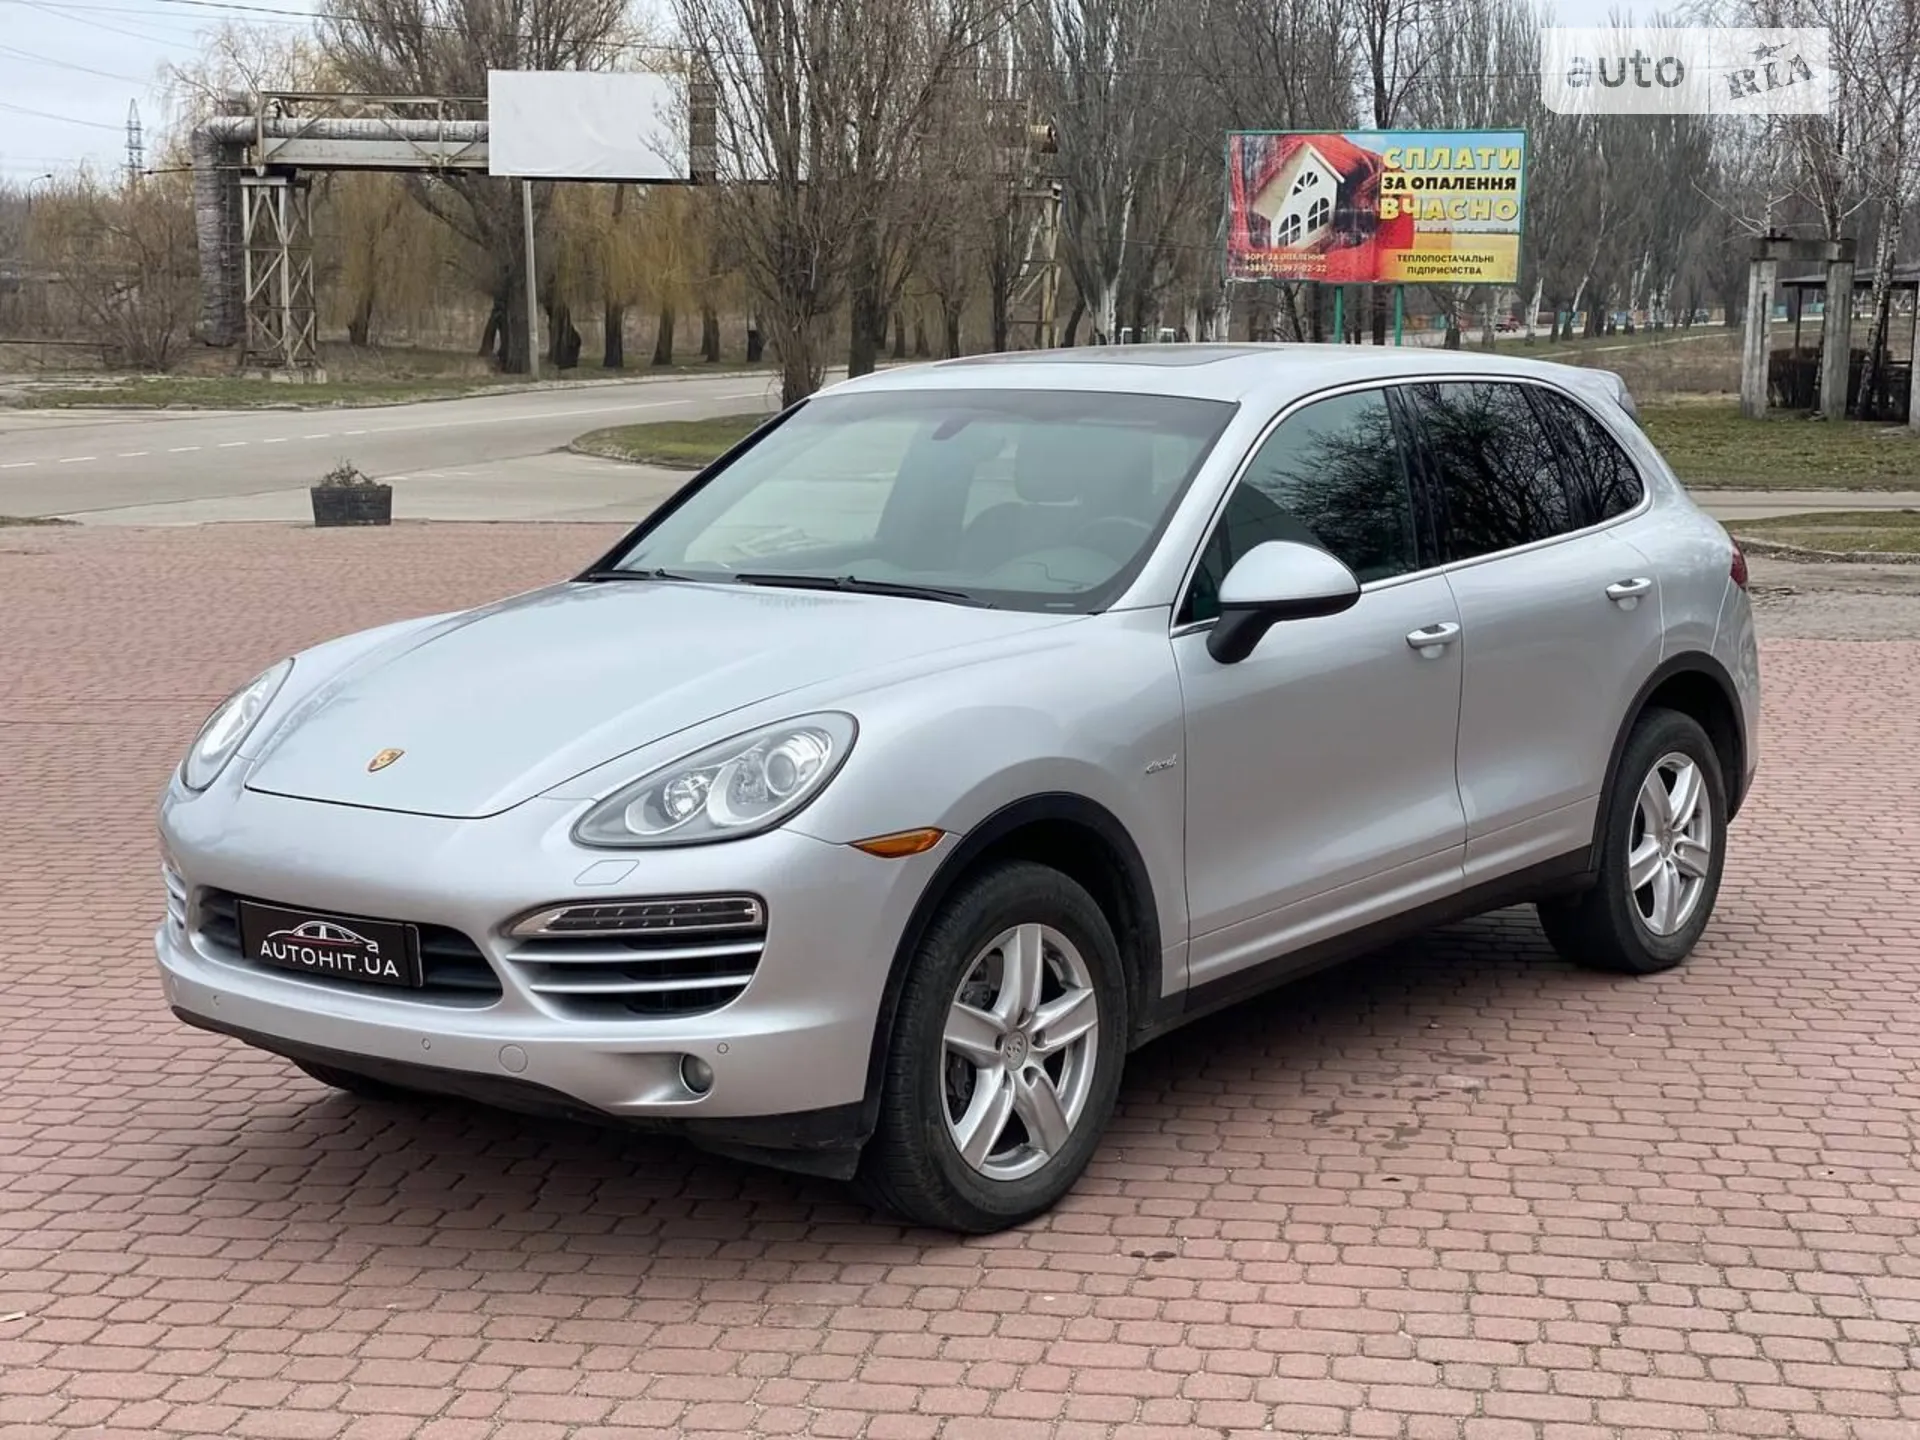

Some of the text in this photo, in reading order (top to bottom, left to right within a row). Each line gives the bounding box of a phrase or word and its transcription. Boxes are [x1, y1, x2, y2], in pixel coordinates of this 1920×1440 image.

[1382, 147, 1521, 170] СПЛАТИ
[1383, 176, 1517, 190] ЗА ОПАЛЕННЯ
[1380, 198, 1519, 222] ВЧАСНО
[1397, 254, 1495, 263] ТЕПЛОПОСТАЧАЛЬНІ
[1406, 266, 1482, 276] ПІДПРИЄМСТВА
[260, 940, 400, 977] AUTOHIT.UA
